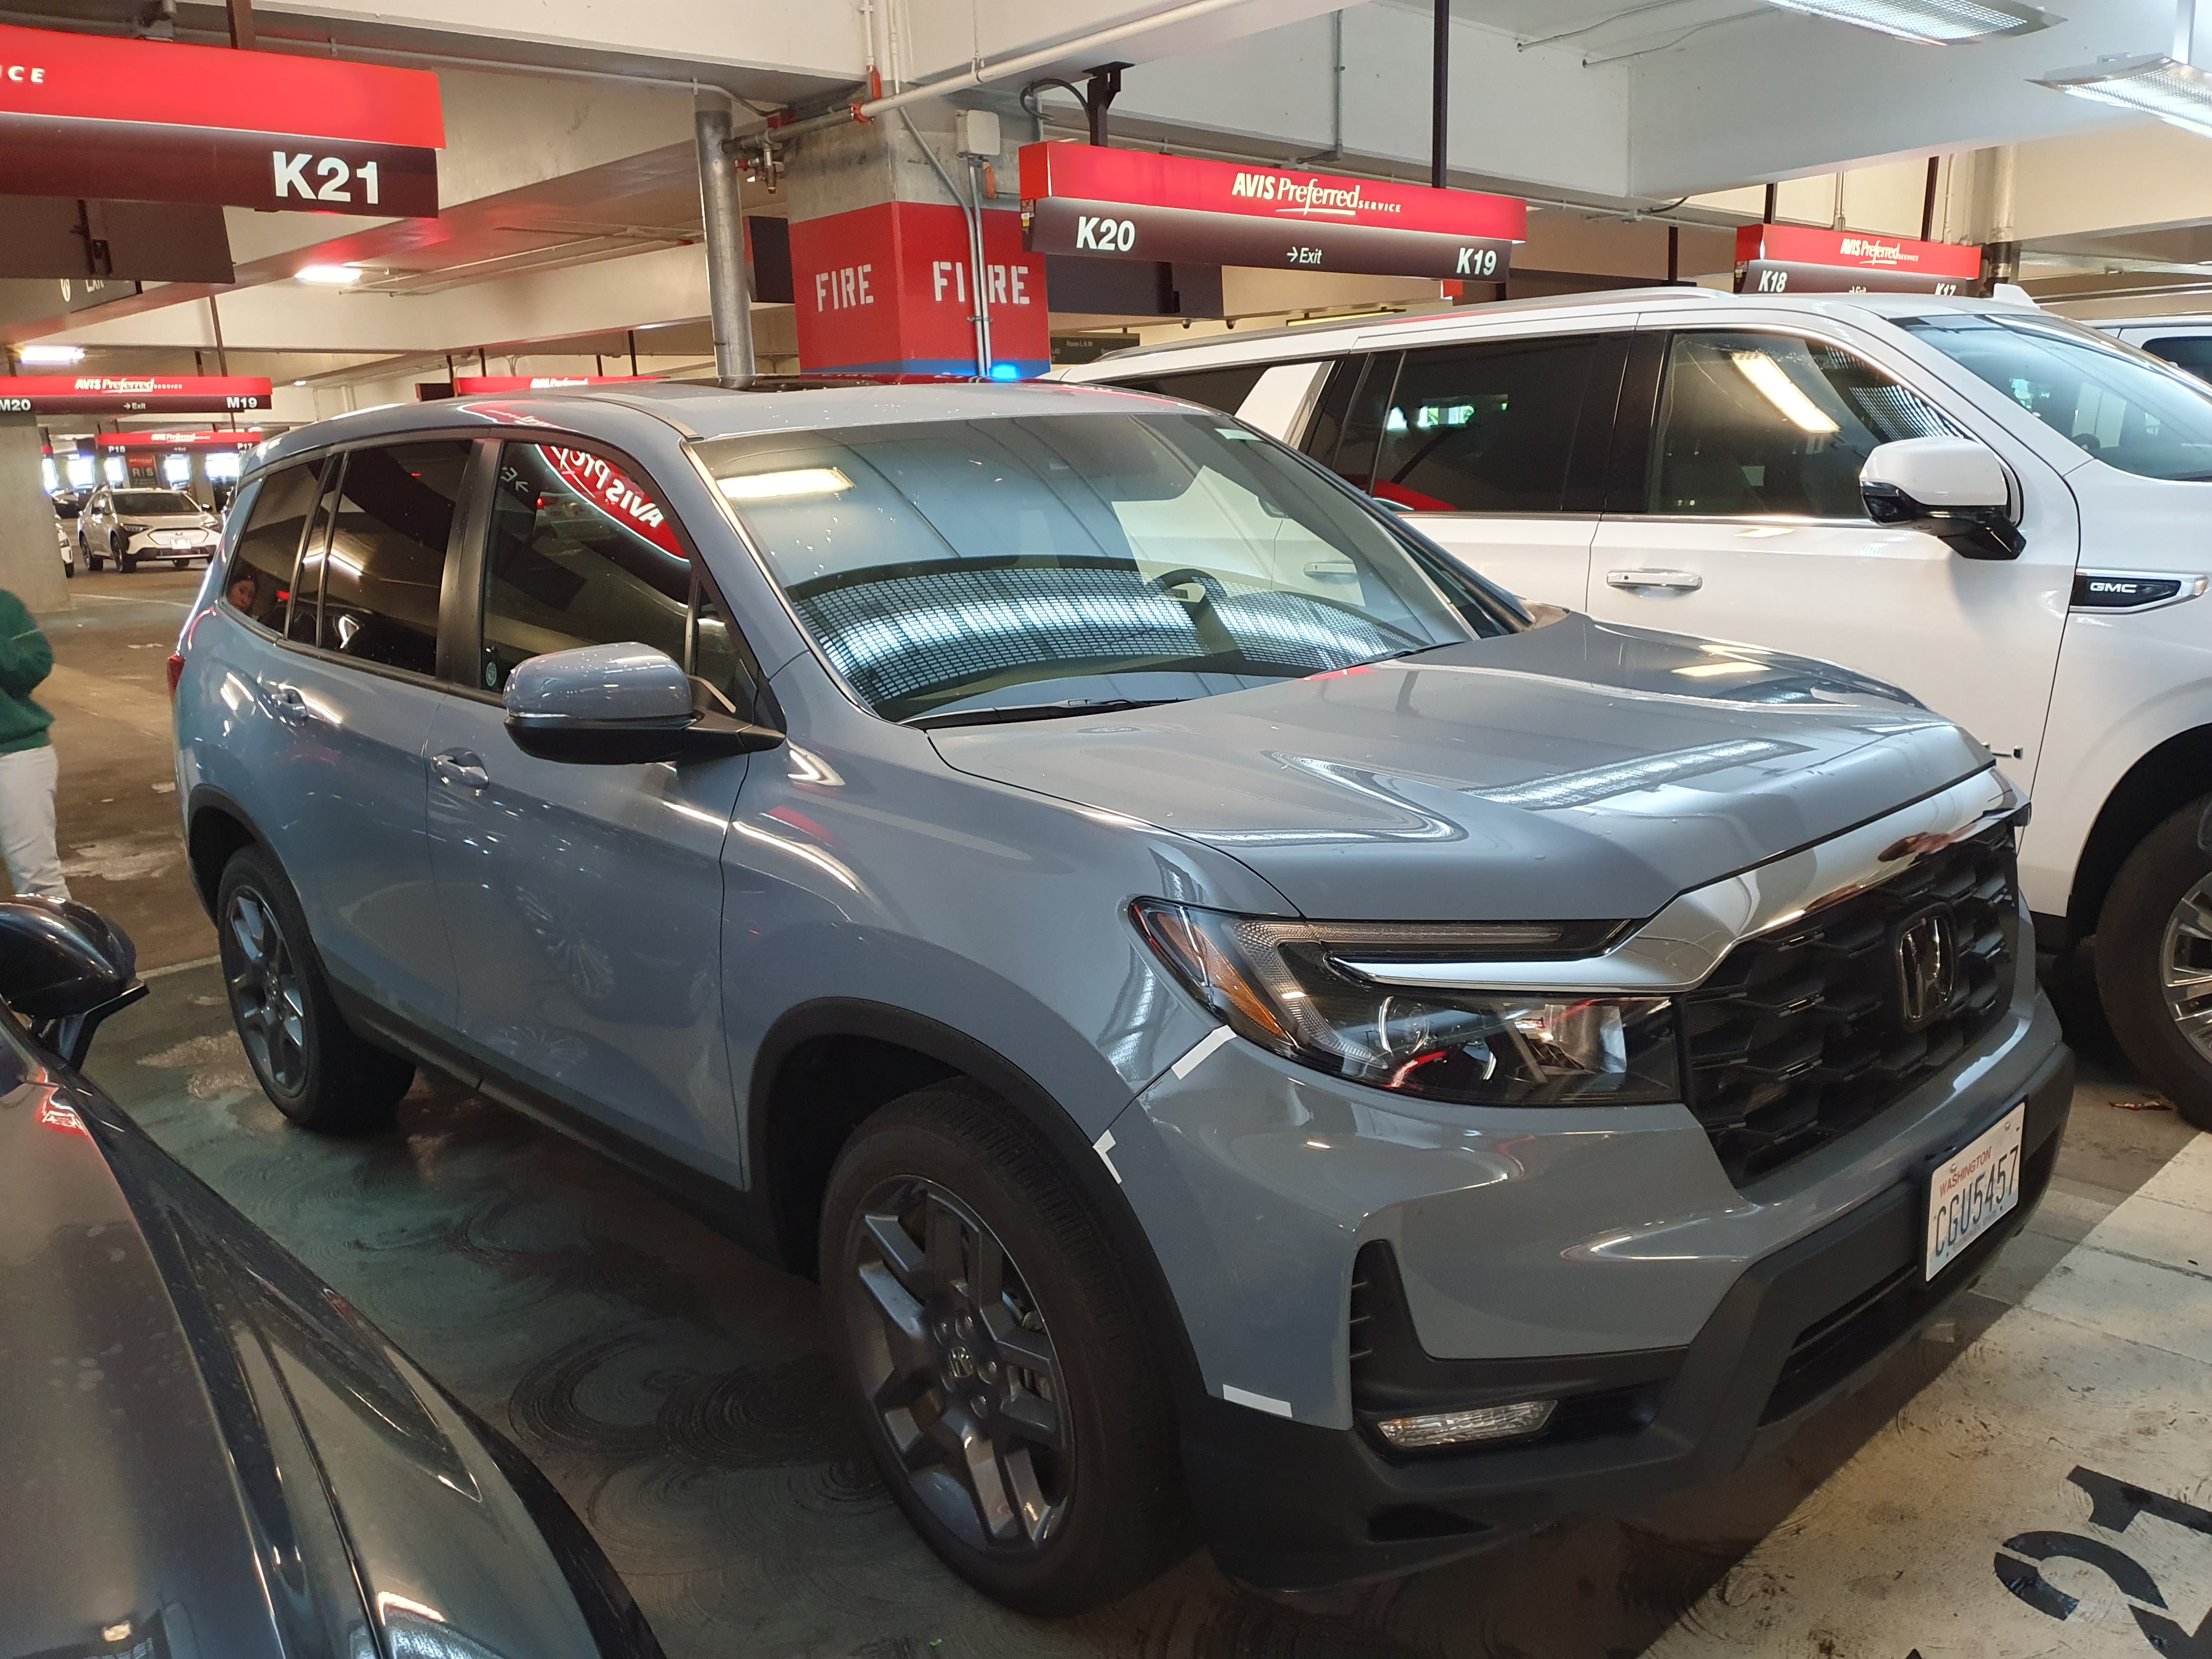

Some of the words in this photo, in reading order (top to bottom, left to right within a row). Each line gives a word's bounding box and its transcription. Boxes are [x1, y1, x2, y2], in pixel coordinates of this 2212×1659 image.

[273, 151, 379, 204] K21
[1232, 173, 1276, 200] AVIS
[1277, 177, 1361, 216] Preferred
[1358, 200, 1402, 213] SERVICE
[1076, 216, 1135, 251] K20
[1299, 247, 1322, 264] Exit
[1456, 247, 1497, 275] K19
[1840, 238, 1861, 256] AVIS
[1860, 240, 1900, 266] Preferred
[816, 264, 874, 312] FIRE
[933, 261, 1030, 304] FIRE
[1758, 270, 1787, 292] K18
[75, 379, 101, 390] AVIS
[0, 399, 31, 411] M20
[227, 397, 257, 409] M19
[2090, 582, 2137, 593] GMC
[1939, 1147, 1991, 1197] WASHINGTON
[1935, 1144, 2019, 1256] CGU5457
